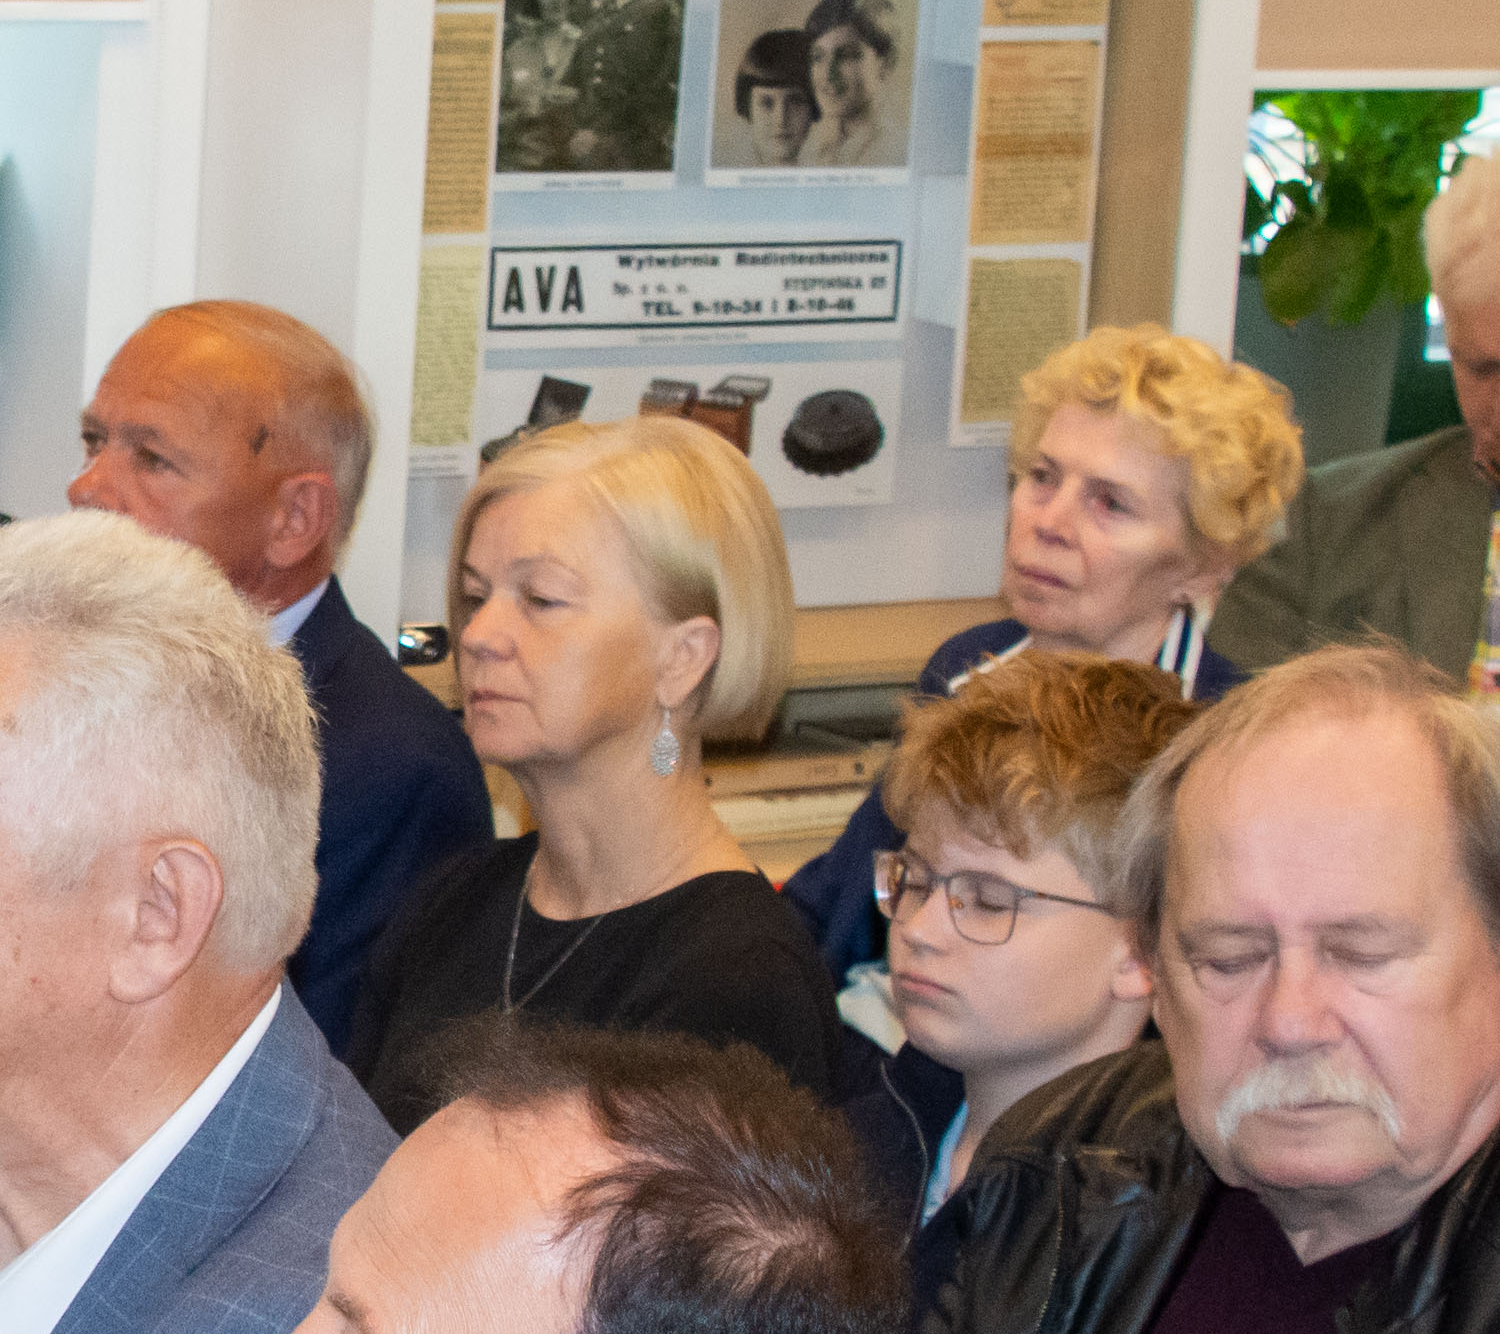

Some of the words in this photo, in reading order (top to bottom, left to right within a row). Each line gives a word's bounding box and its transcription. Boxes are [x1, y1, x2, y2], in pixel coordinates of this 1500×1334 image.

[502, 265, 585, 313] AVA
[617, 253, 720, 271] Wytwórnia
[735, 250, 890, 267] Radiotechniczna
[642, 301, 681, 317] TEL.
